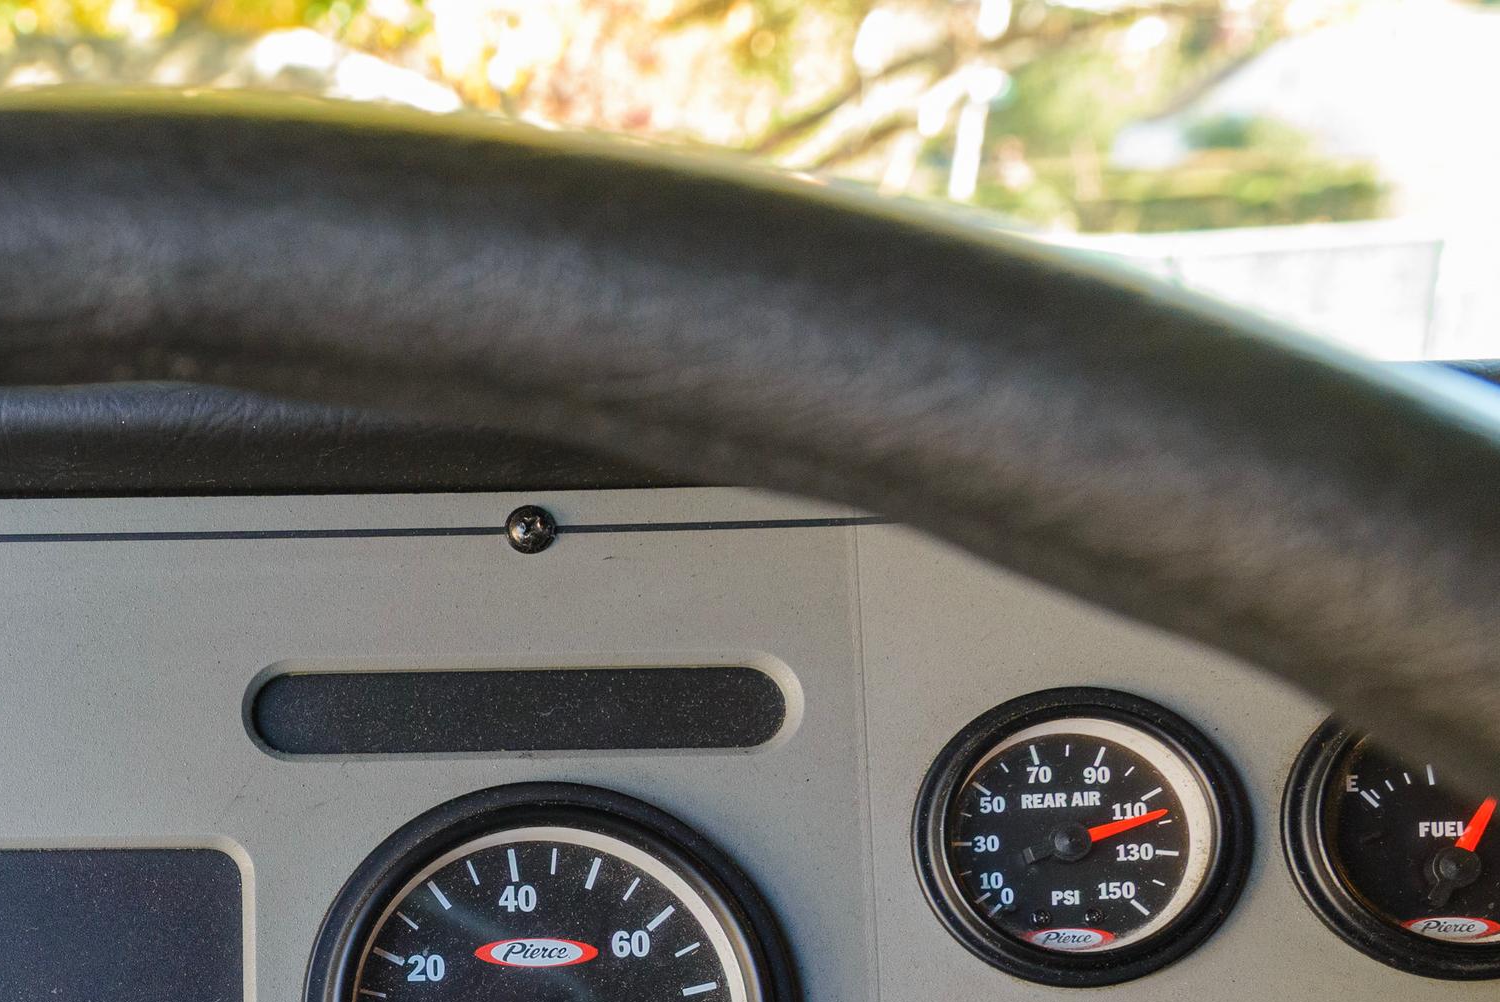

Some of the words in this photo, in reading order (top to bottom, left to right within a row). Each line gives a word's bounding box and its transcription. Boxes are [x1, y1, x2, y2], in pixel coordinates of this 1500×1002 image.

[1027, 767, 1052, 784] 70
[1083, 767, 1110, 784] 90
[1346, 775, 1359, 792] E
[979, 797, 1005, 814] 50
[1021, 792, 1067, 809] REAR
[1071, 791, 1100, 808] AIR
[1112, 802, 1147, 820] 110
[974, 836, 999, 852] 30
[1116, 844, 1154, 861] 130
[979, 873, 1003, 889] 10
[498, 885, 537, 912] 40
[1001, 888, 1014, 904] 0
[1052, 890, 1080, 905] PSI
[1098, 882, 1135, 899] 150
[1421, 920, 1476, 934] Pierce
[611, 931, 650, 958] 60
[1043, 931, 1092, 944] Pierce
[505, 942, 570, 961] Pierce
[407, 955, 445, 982] 20
